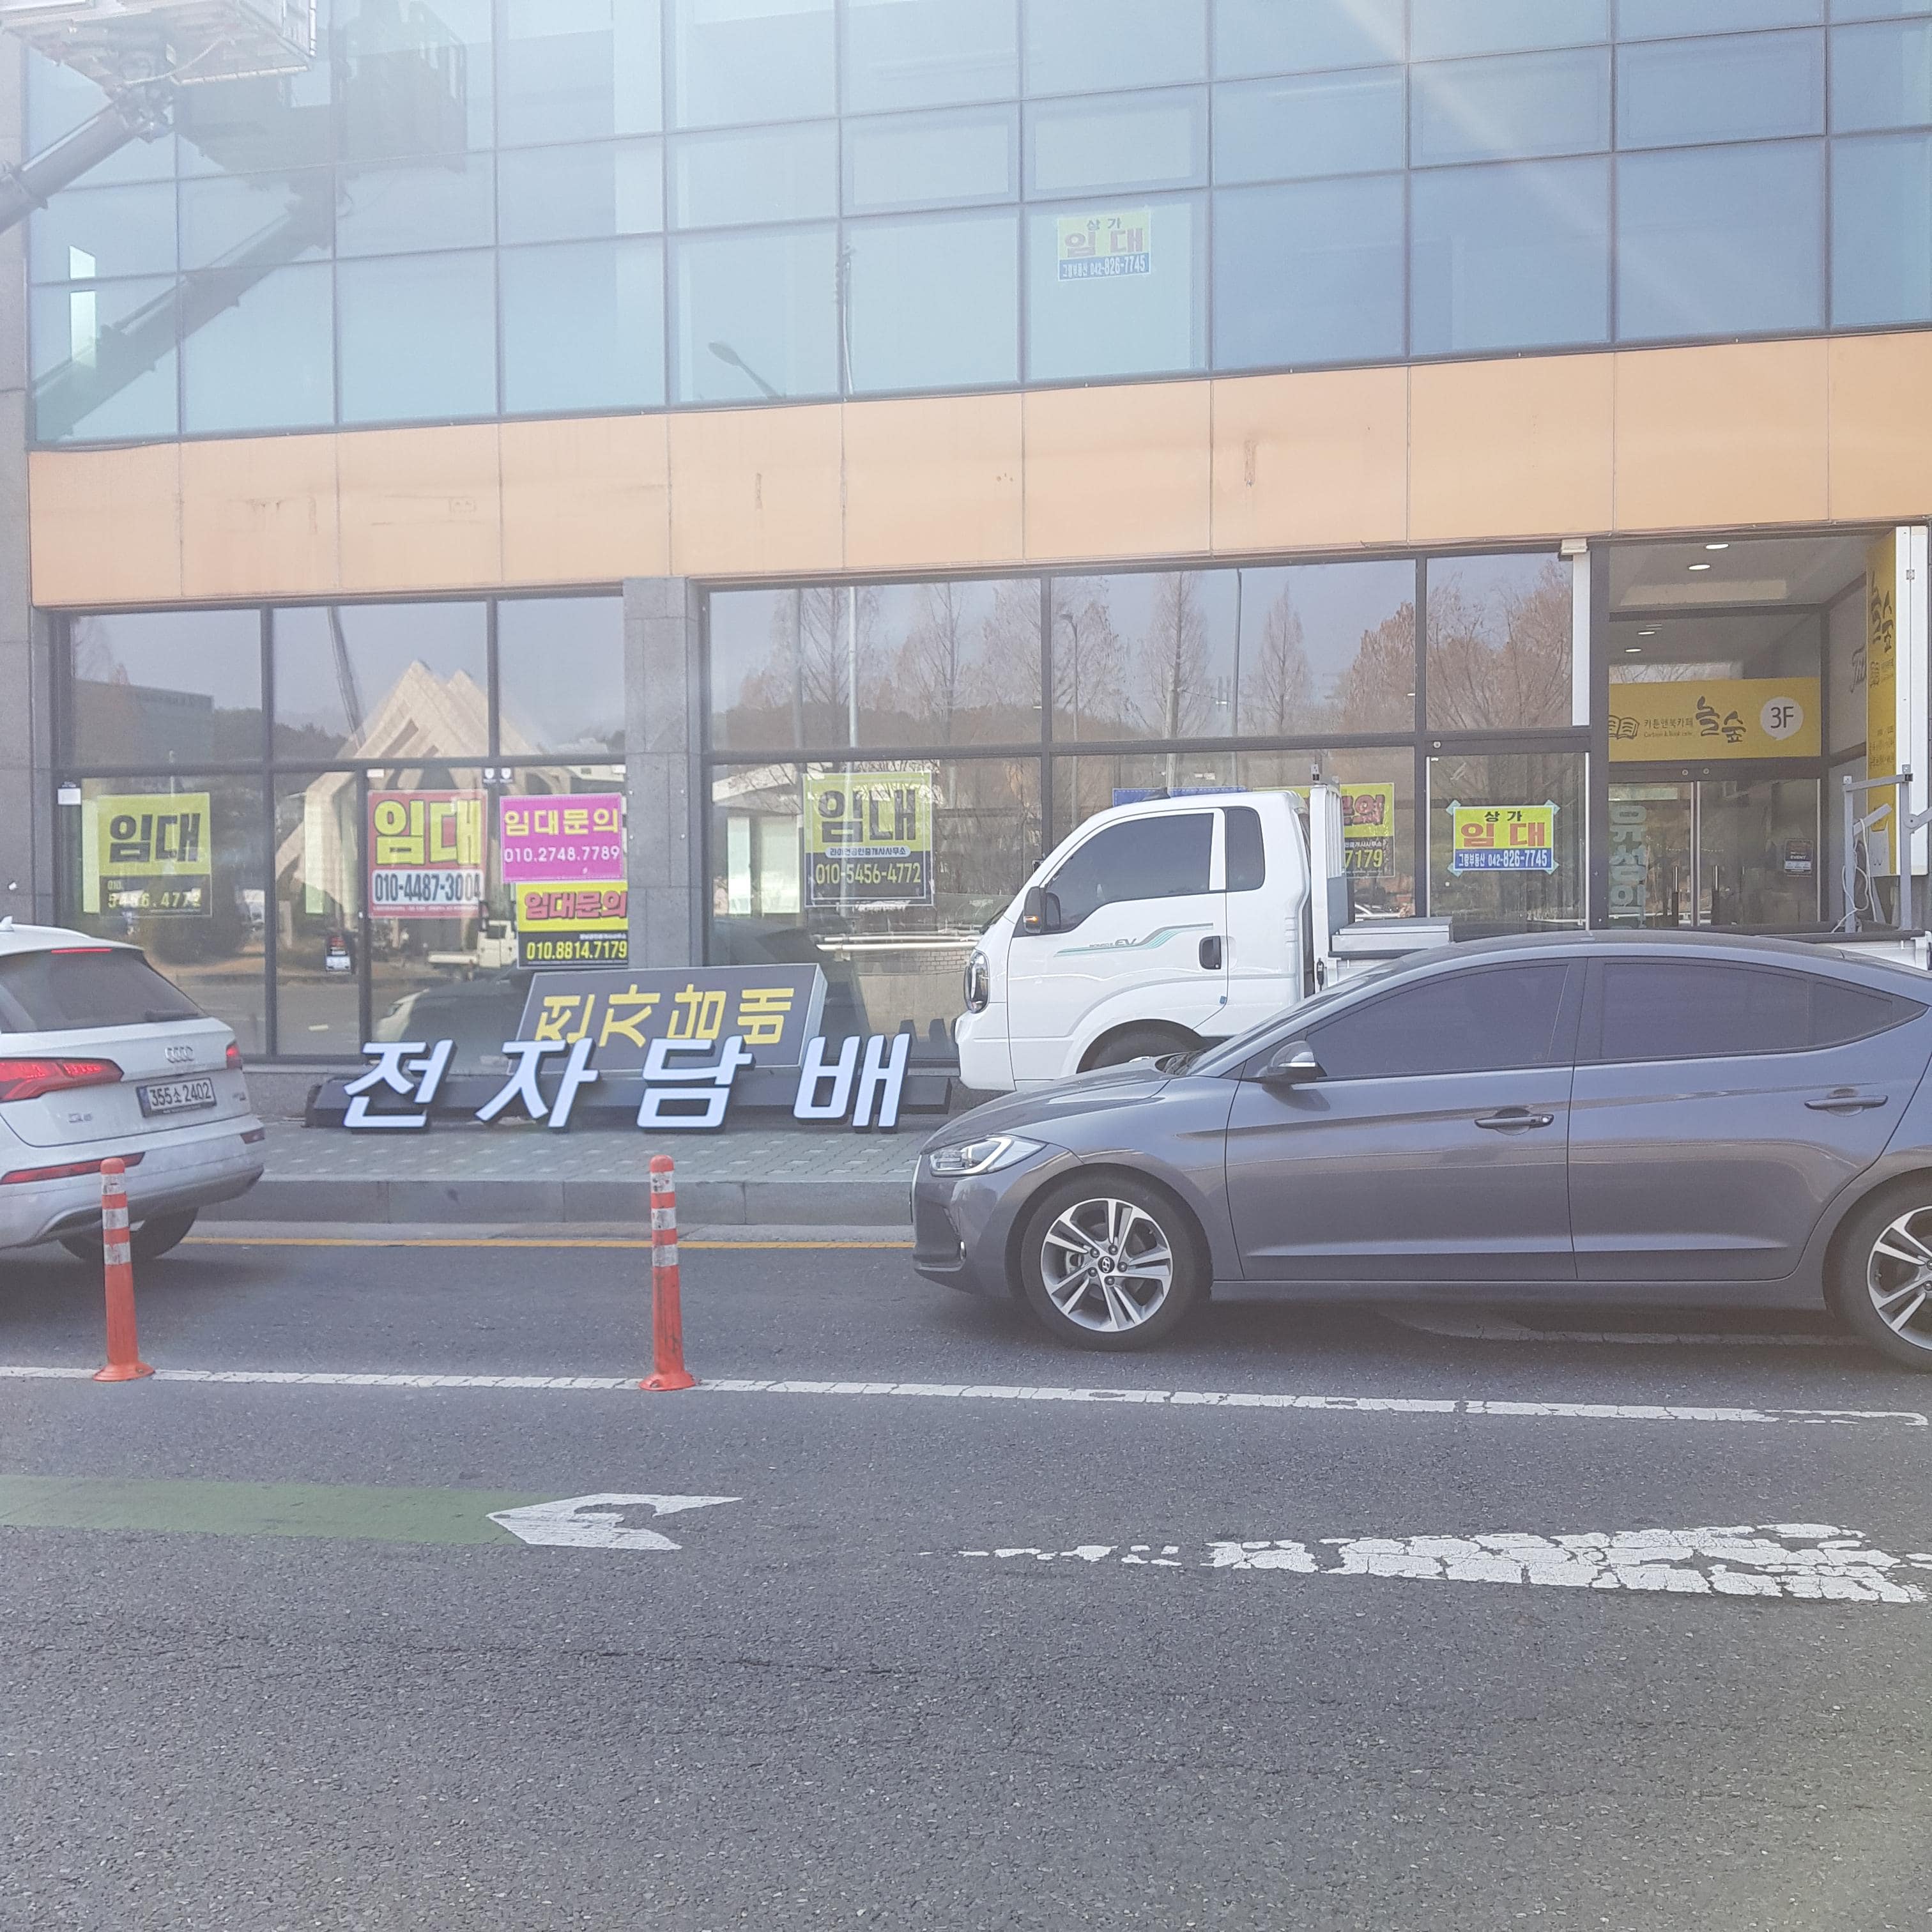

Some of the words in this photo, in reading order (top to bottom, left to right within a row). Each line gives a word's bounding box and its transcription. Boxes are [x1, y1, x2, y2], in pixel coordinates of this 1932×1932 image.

[1064, 228, 1143, 257] 임대
[1090, 254, 1146, 275] 042-826-7745
[1770, 707, 1794, 729] 3F
[504, 808, 618, 836] 임대문의
[818, 790, 916, 843] 임대
[110, 813, 201, 863] 임대
[374, 799, 482, 865] 임대
[1460, 822, 1545, 847] 임대
[504, 845, 620, 863] 010.2748.7789
[1488, 850, 1548, 868] 042-826-7745
[815, 862, 921, 885] 010-5456-4772
[525, 891, 628, 919] 임대문의
[526, 940, 627, 960] 010.8814.7179
[535, 984, 795, 1048] 전자담배
[343, 1033, 912, 1129] 전자담배
